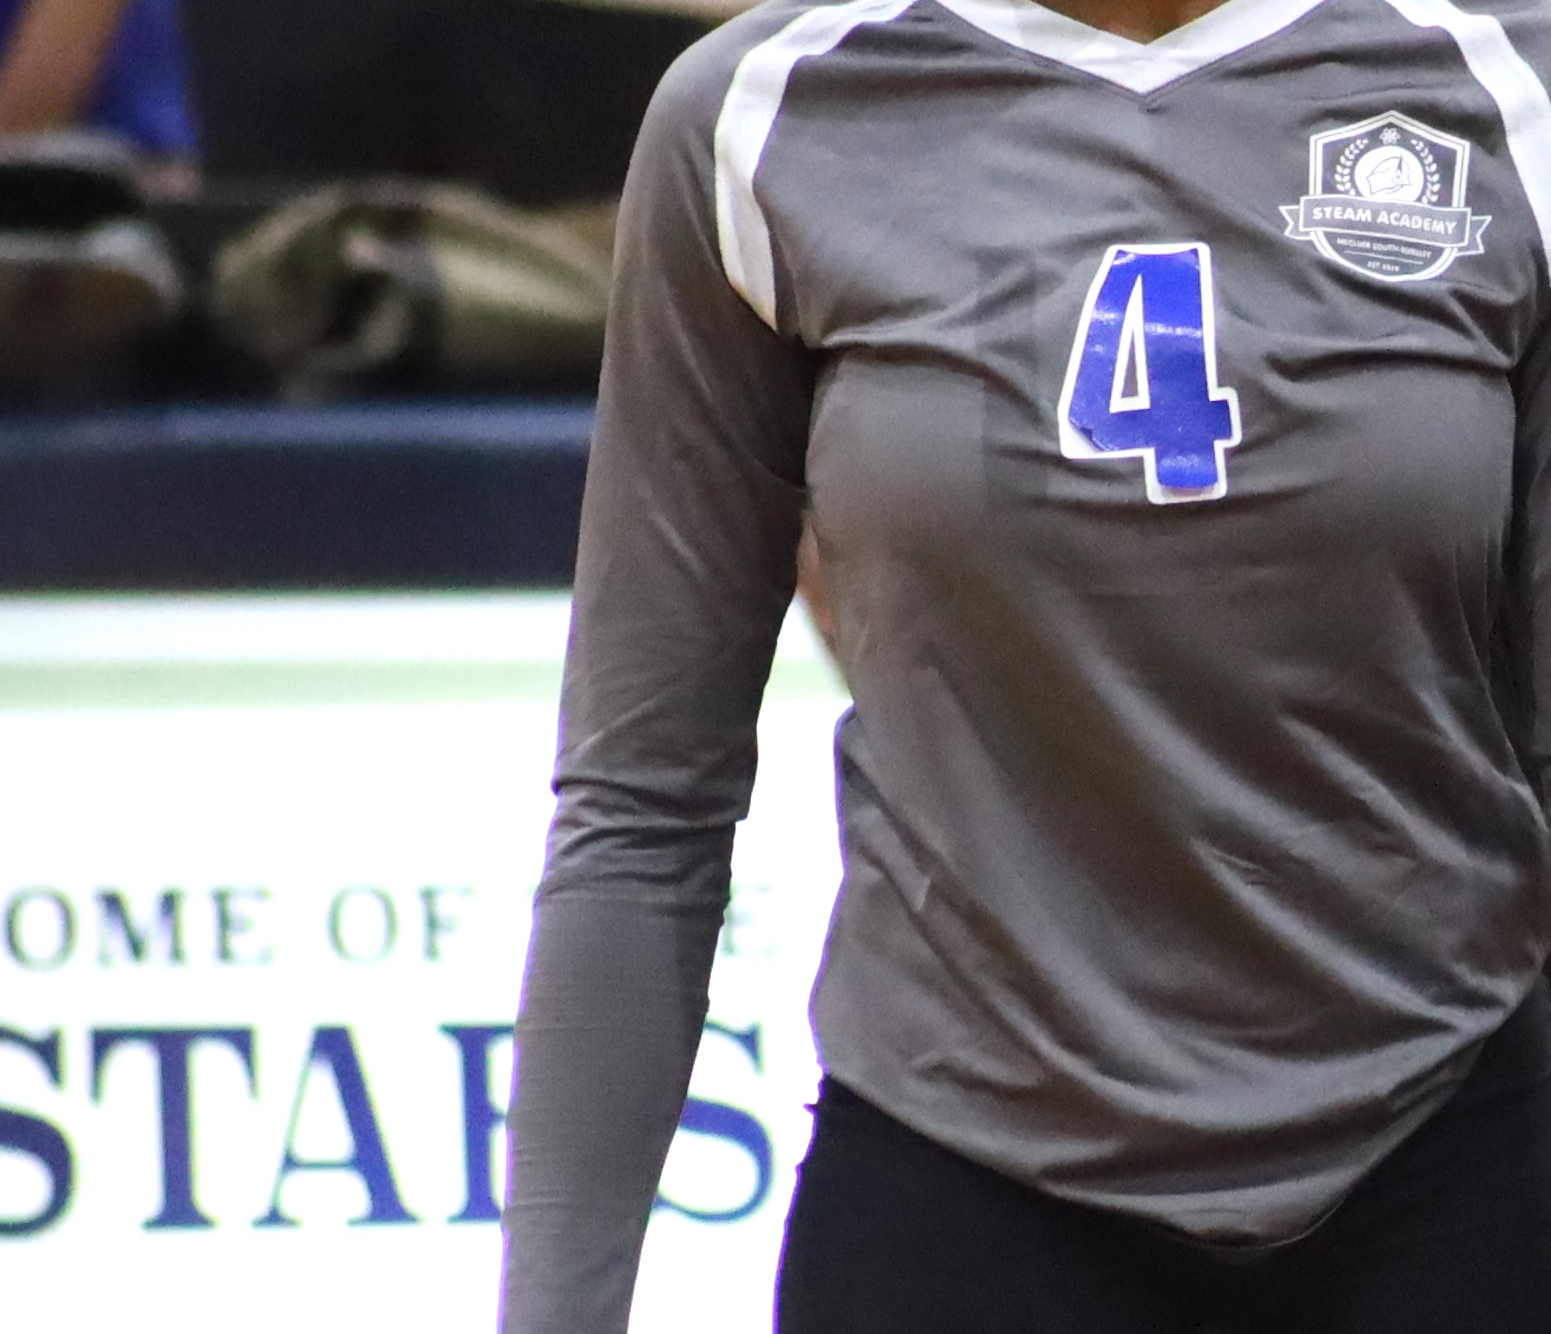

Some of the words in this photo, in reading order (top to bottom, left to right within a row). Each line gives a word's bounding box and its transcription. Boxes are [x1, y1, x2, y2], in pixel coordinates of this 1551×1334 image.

[1312, 207, 1372, 222] STEAM
[1376, 210, 1458, 235] ACADEMY
[1058, 242, 1242, 505] 4
[324, 882, 477, 965] OF
